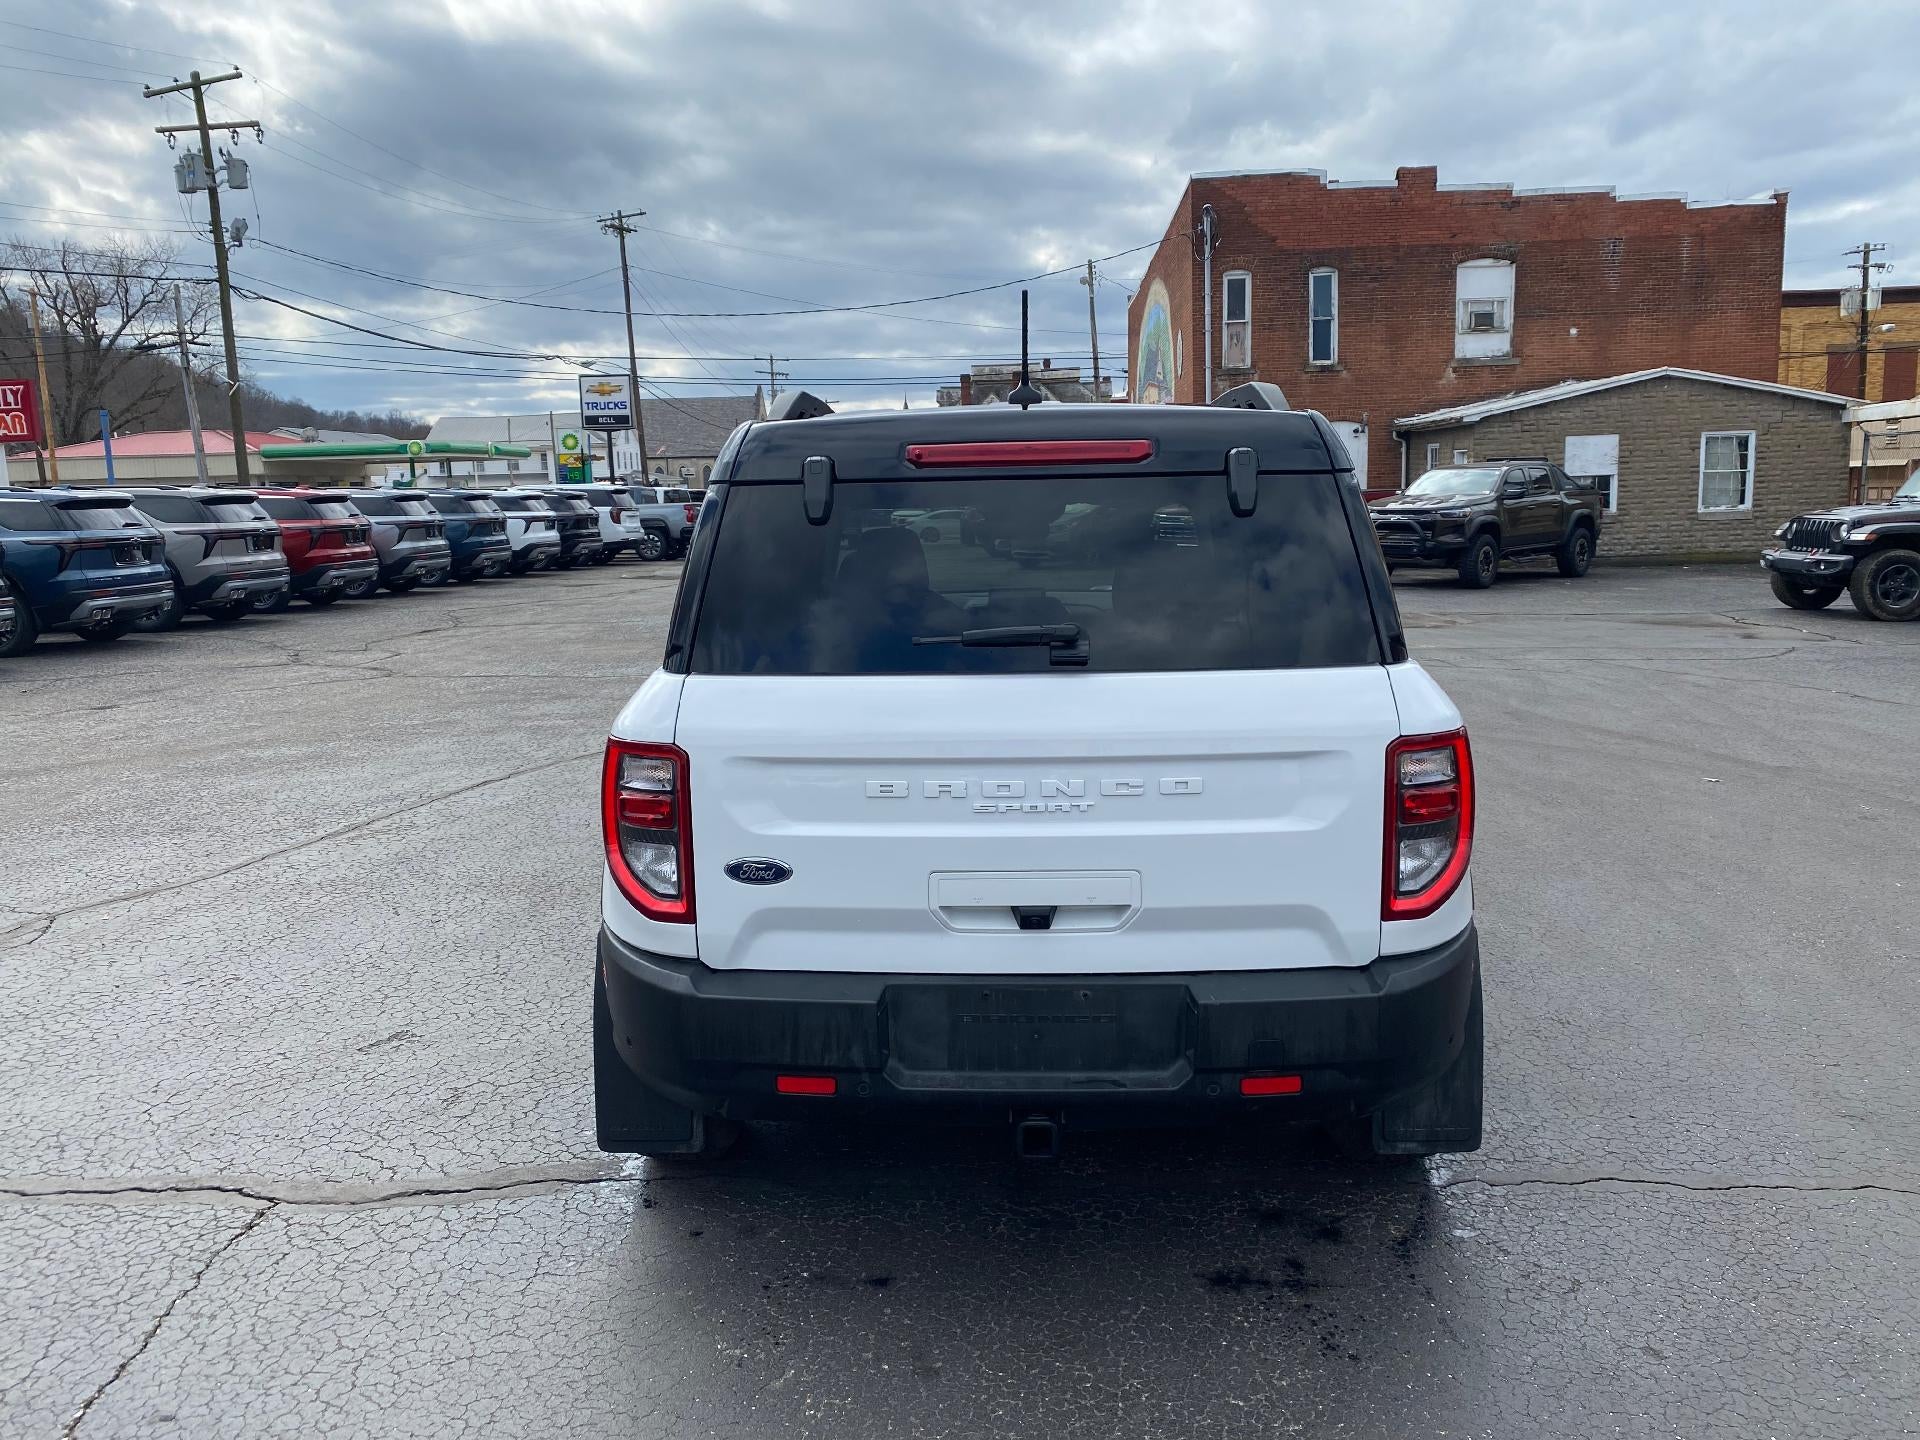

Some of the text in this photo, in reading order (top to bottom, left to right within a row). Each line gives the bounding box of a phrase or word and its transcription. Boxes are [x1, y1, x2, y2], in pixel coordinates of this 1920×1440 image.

[584, 401, 628, 411] TRUCKS
[865, 777, 1203, 799] BRONCO
[973, 801, 1096, 813] SPORT
[739, 862, 776, 880] Ford
